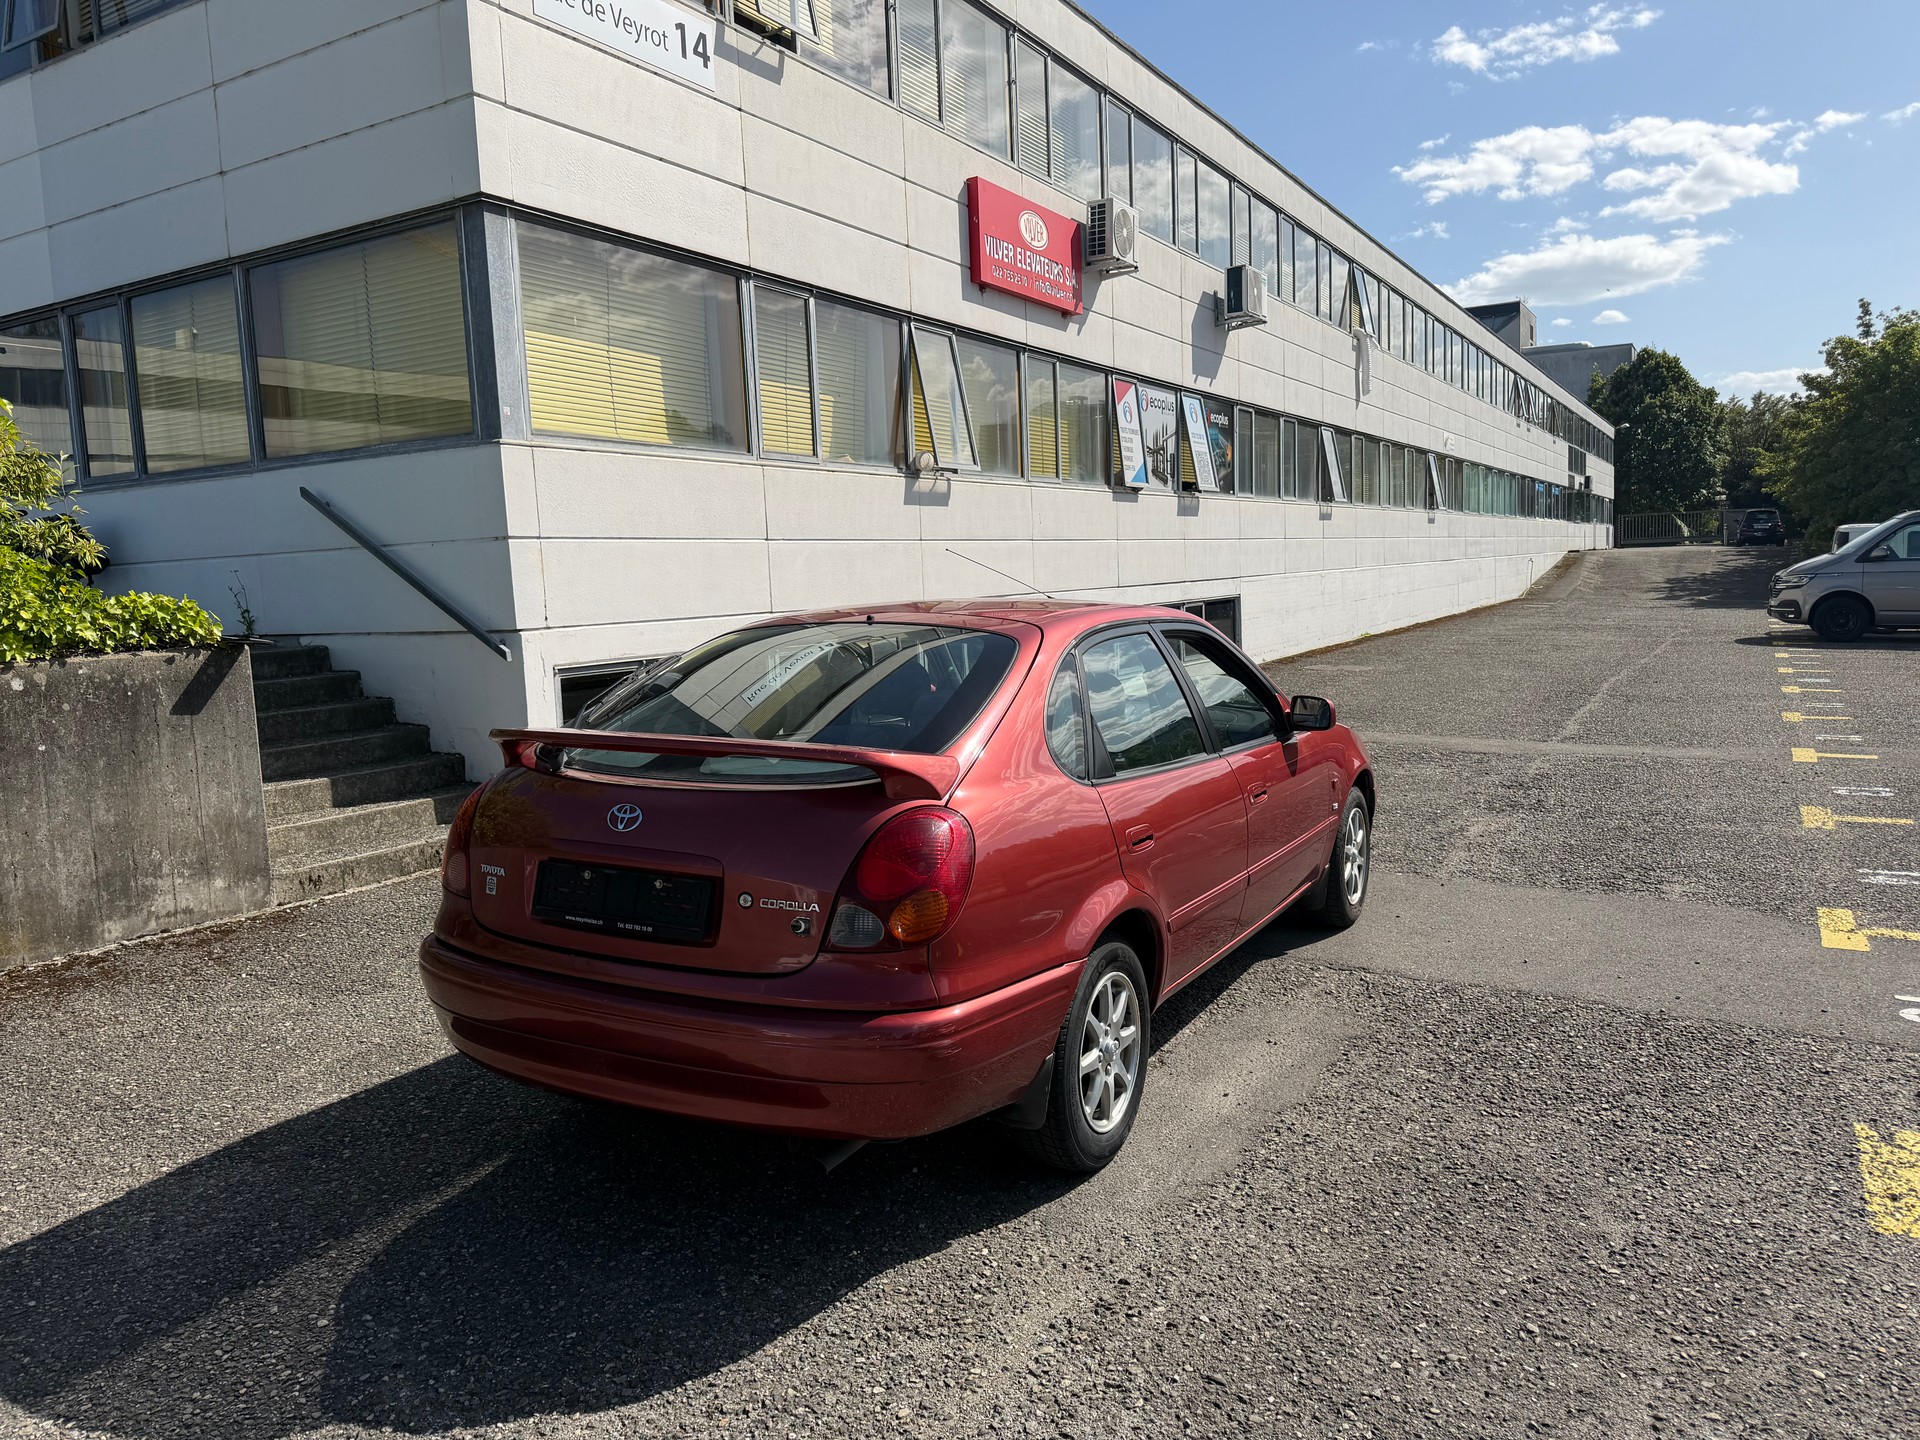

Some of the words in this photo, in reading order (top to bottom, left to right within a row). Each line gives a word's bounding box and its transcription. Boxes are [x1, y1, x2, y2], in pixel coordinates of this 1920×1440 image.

[581, 0, 606, 22] de
[609, 3, 669, 52] Veyrot
[674, 22, 711, 70] 14
[984, 233, 1015, 266] VILVER
[1017, 246, 1063, 284] ELEVATEURS
[1149, 396, 1174, 415] ecoplus
[1210, 412, 1229, 428] ecoplus
[480, 863, 506, 877] TOYOTA
[759, 898, 820, 913] COROLLA
